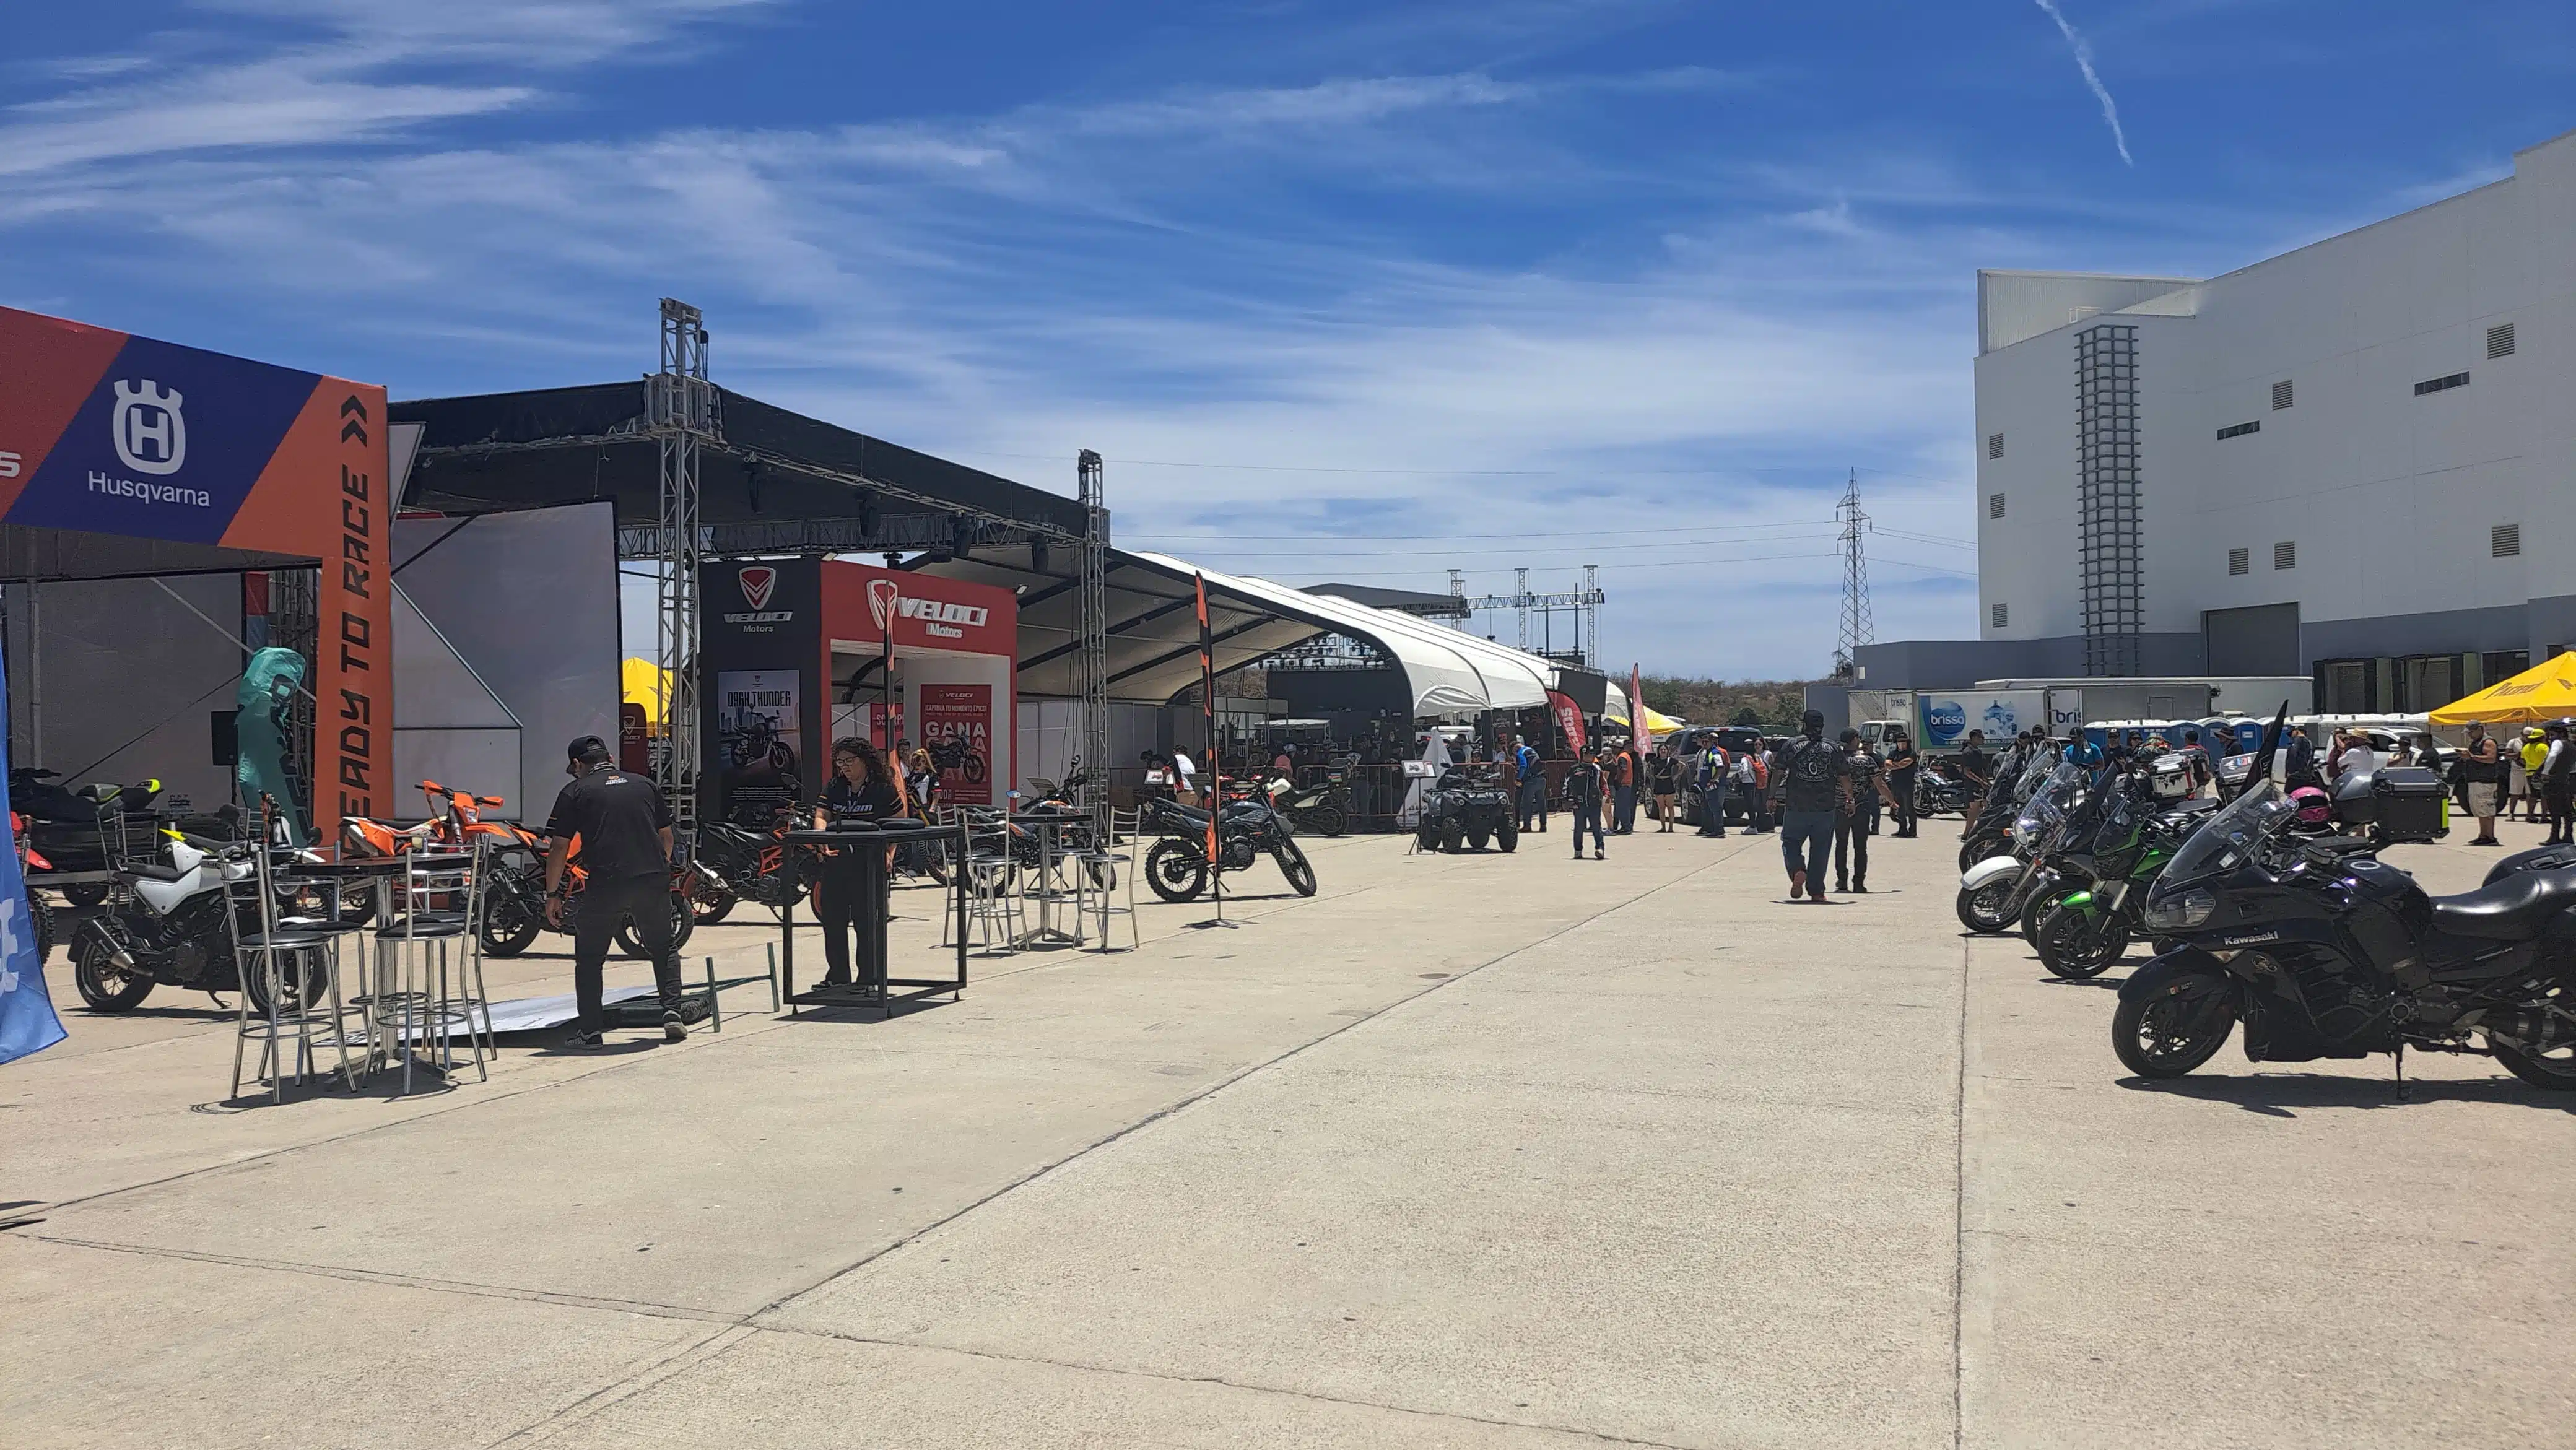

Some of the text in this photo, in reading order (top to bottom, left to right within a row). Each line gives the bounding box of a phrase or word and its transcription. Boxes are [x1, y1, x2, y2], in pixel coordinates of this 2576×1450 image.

[88, 470, 210, 506] Husqvarna
[342, 463, 370, 599] RACE
[723, 611, 793, 623] VELOCI
[897, 597, 988, 627] VELOCI
[743, 625, 774, 633] Motors
[926, 622, 963, 638] Motors
[341, 610, 370, 674] TO
[925, 721, 986, 737] GANA
[2224, 931, 2279, 945] Kawasaki
